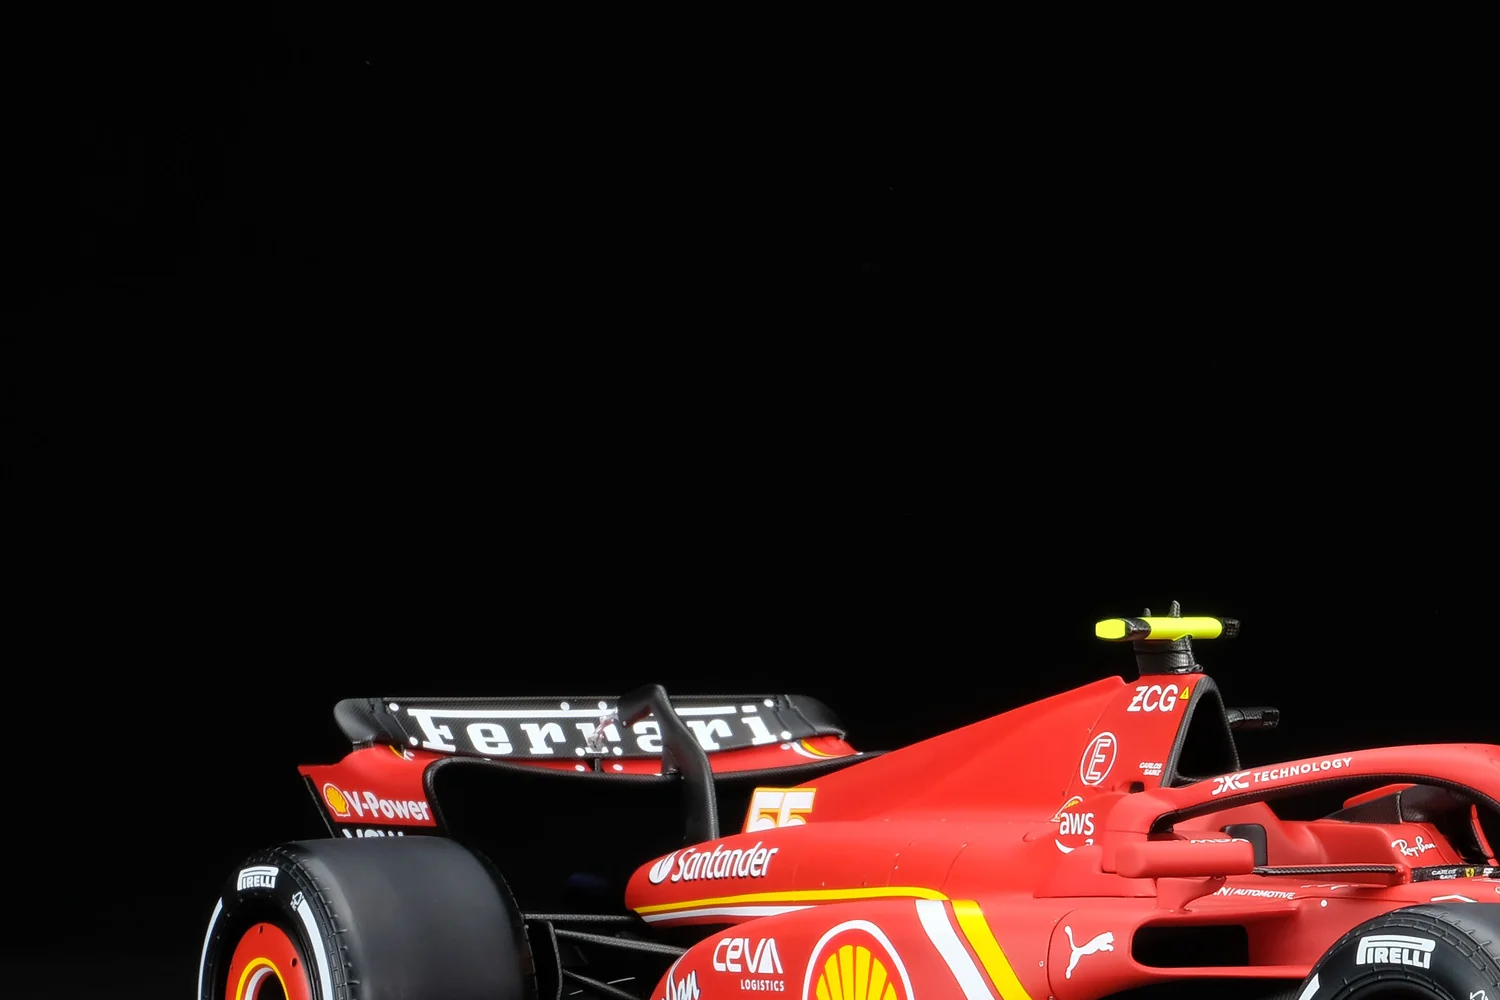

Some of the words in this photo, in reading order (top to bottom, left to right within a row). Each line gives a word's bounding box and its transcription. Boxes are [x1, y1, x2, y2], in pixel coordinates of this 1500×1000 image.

[1127, 684, 1178, 712] ZCG
[407, 704, 777, 756] Ferrari
[1253, 757, 1352, 783] TECHNOLOGY
[343, 790, 430, 821] V-Power
[1060, 812, 1095, 836] aws
[671, 841, 779, 882] Santander
[237, 866, 279, 891] PIRELLI
[1234, 889, 1296, 900] AUTOMOTIVE
[1356, 935, 1436, 970] PIRELLI
[741, 979, 785, 992] LOGISTICS
